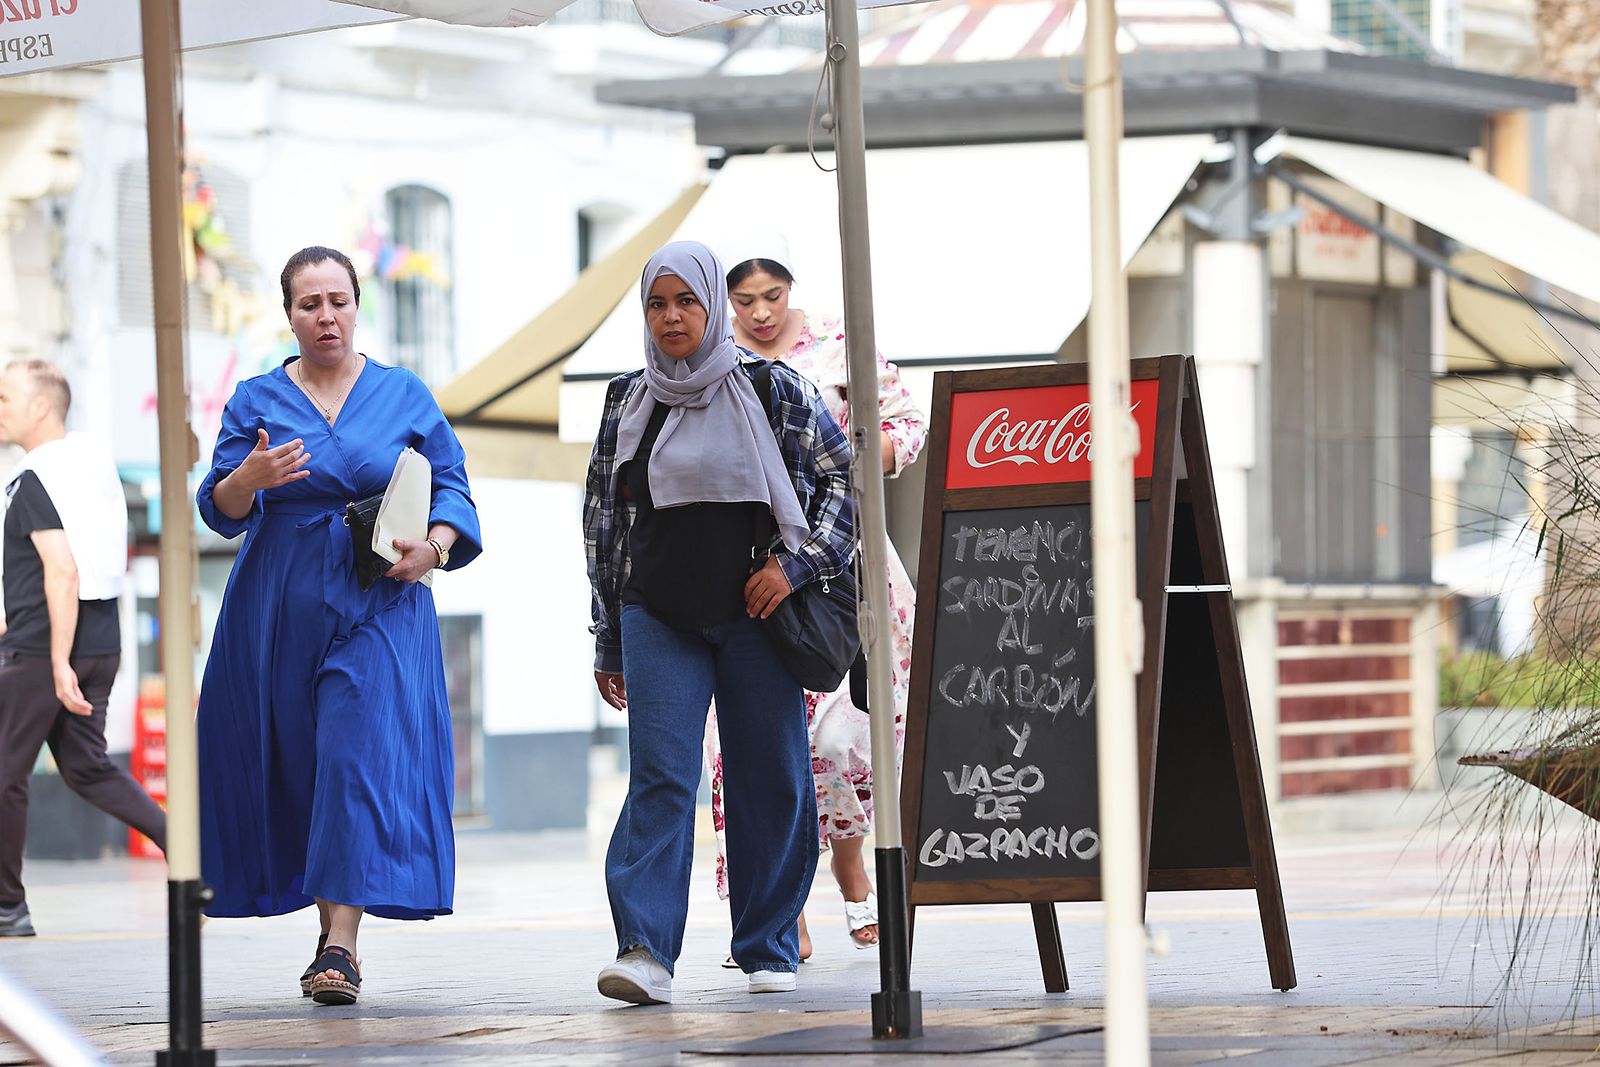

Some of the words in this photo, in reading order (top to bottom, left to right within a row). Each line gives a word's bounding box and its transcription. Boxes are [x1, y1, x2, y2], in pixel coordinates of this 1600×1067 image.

[966, 399, 1142, 469] Coca-Co
[996, 611, 1044, 655] AL
[1005, 721, 1032, 758] Y
[942, 764, 1045, 796] VASO
[974, 793, 1027, 822] DE
[919, 825, 1101, 867] GAZPACHO
